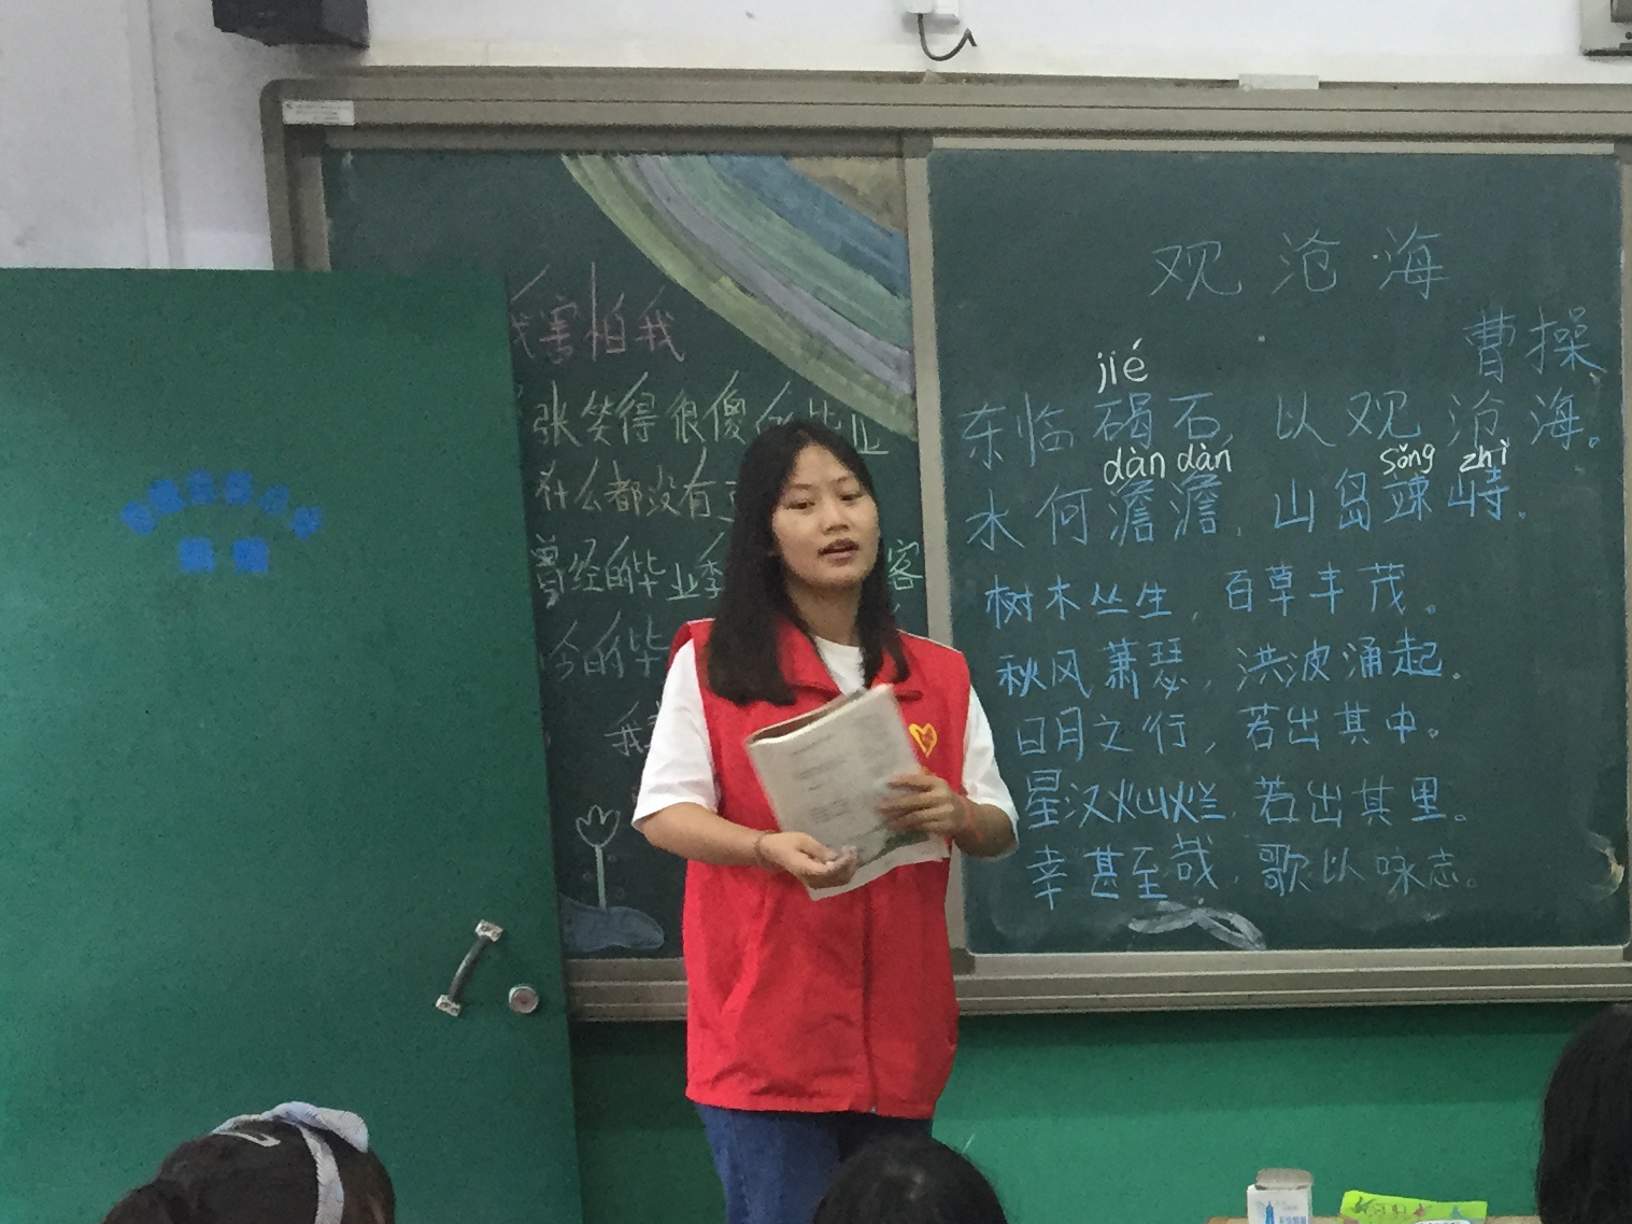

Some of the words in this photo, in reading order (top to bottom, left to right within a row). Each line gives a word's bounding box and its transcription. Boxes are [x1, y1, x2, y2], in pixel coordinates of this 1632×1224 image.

[1150, 225, 1449, 300] 观沧海
[1097, 337, 1150, 394] jié
[1462, 305, 1607, 384] 曹操
[1104, 447, 1165, 484] dàn
[1177, 444, 1233, 473] dàn
[1459, 439, 1510, 473] zhì
